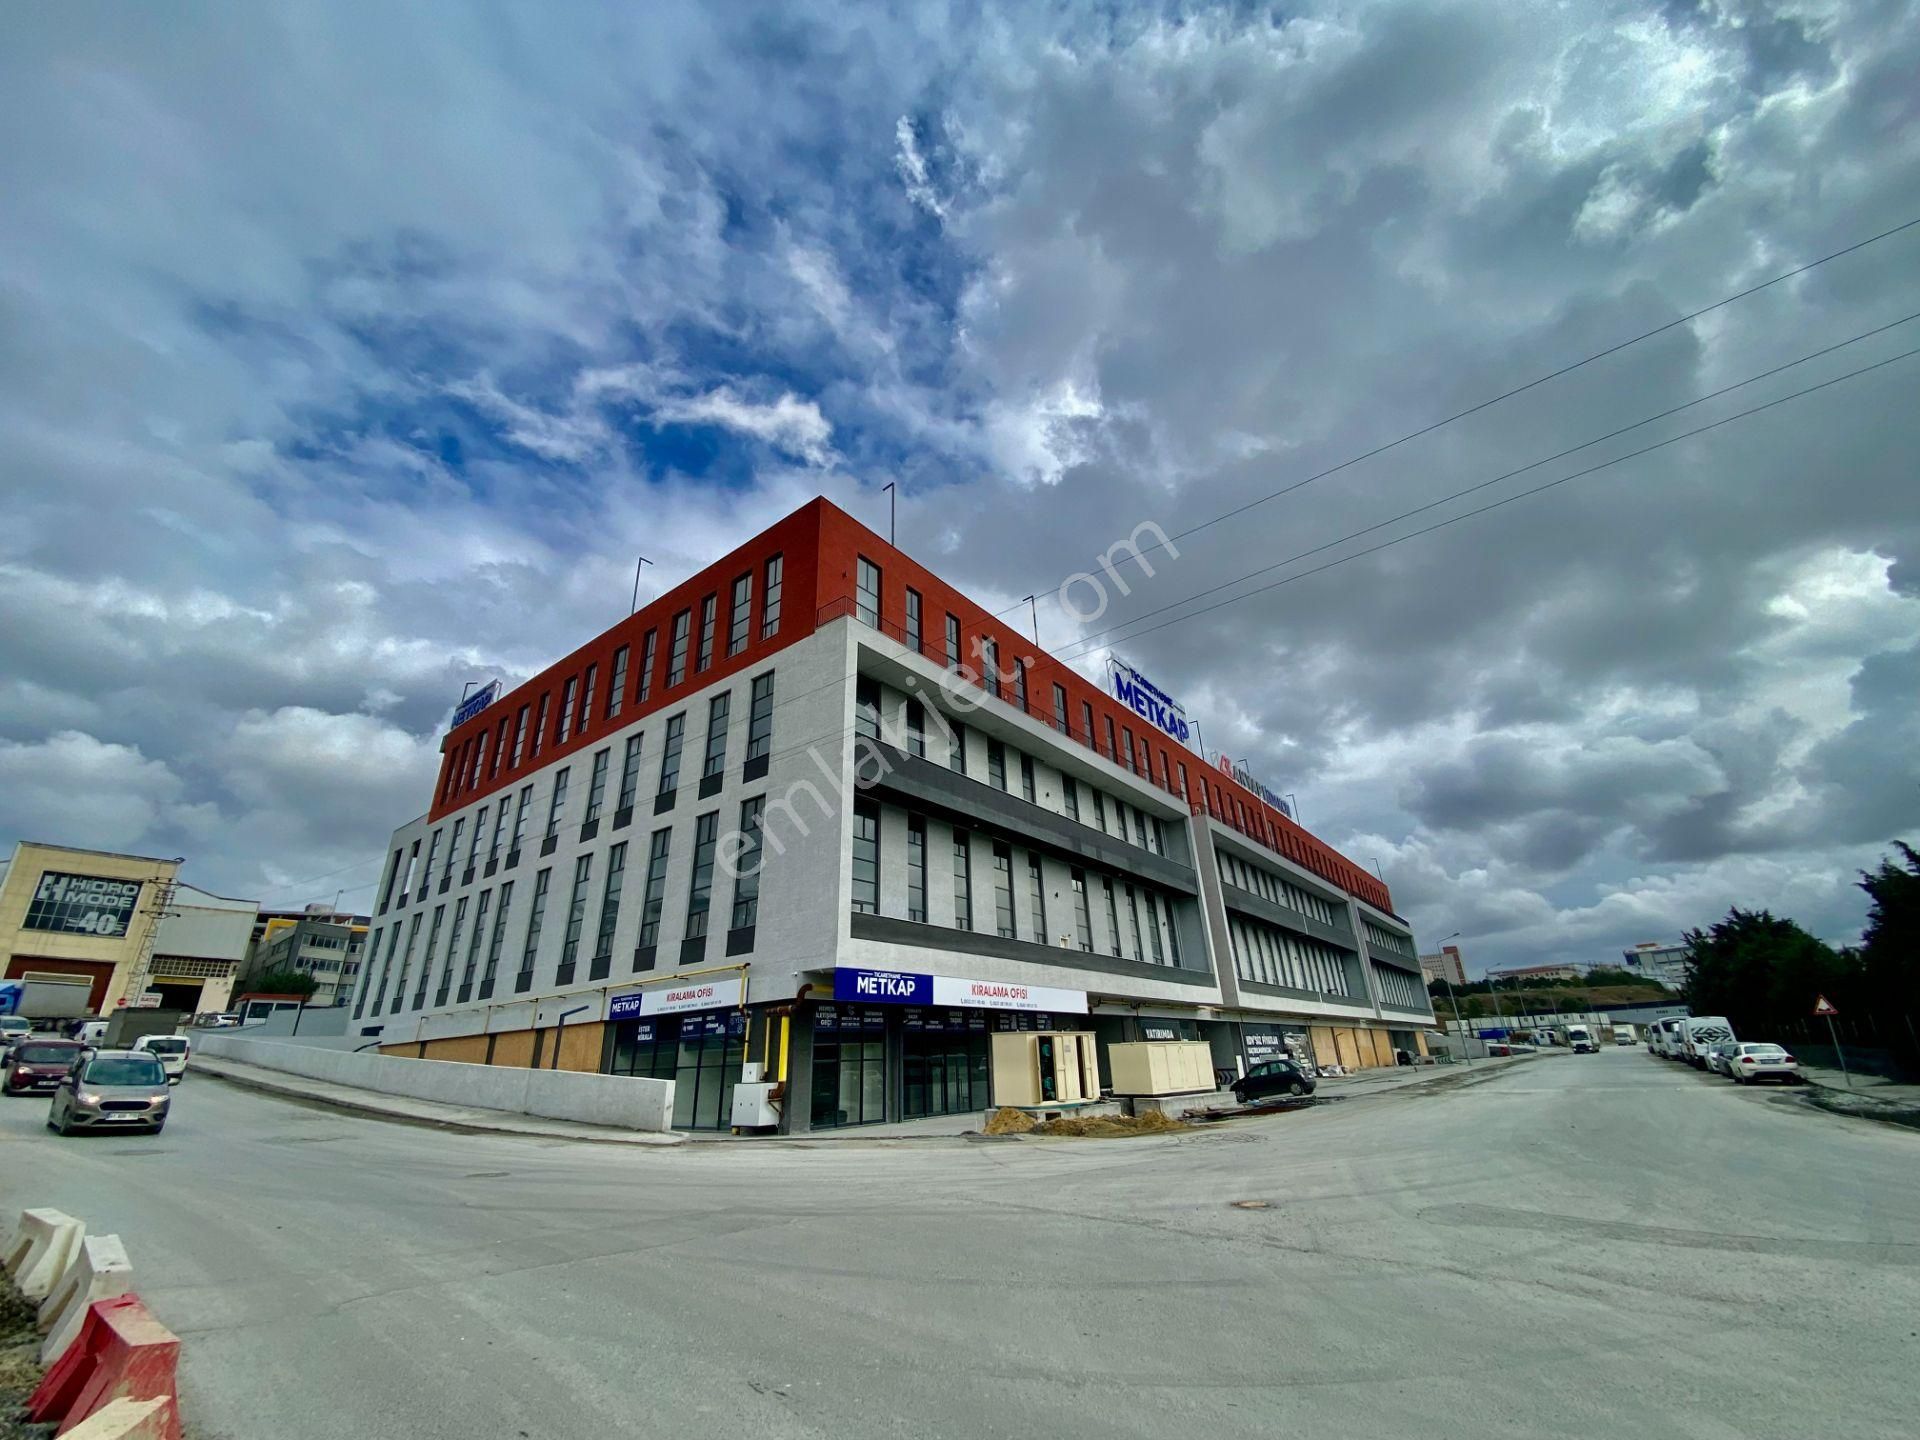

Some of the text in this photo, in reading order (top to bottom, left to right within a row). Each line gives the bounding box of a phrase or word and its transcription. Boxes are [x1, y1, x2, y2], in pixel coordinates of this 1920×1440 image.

[1115, 672, 1189, 743] METKAP
[65, 891, 134, 908] MODE
[79, 911, 117, 935] 40
[857, 976, 916, 997] METKAP
[971, 982, 1028, 999] KİRALAMA OFİSİ
[611, 1000, 640, 1013] METKAP
